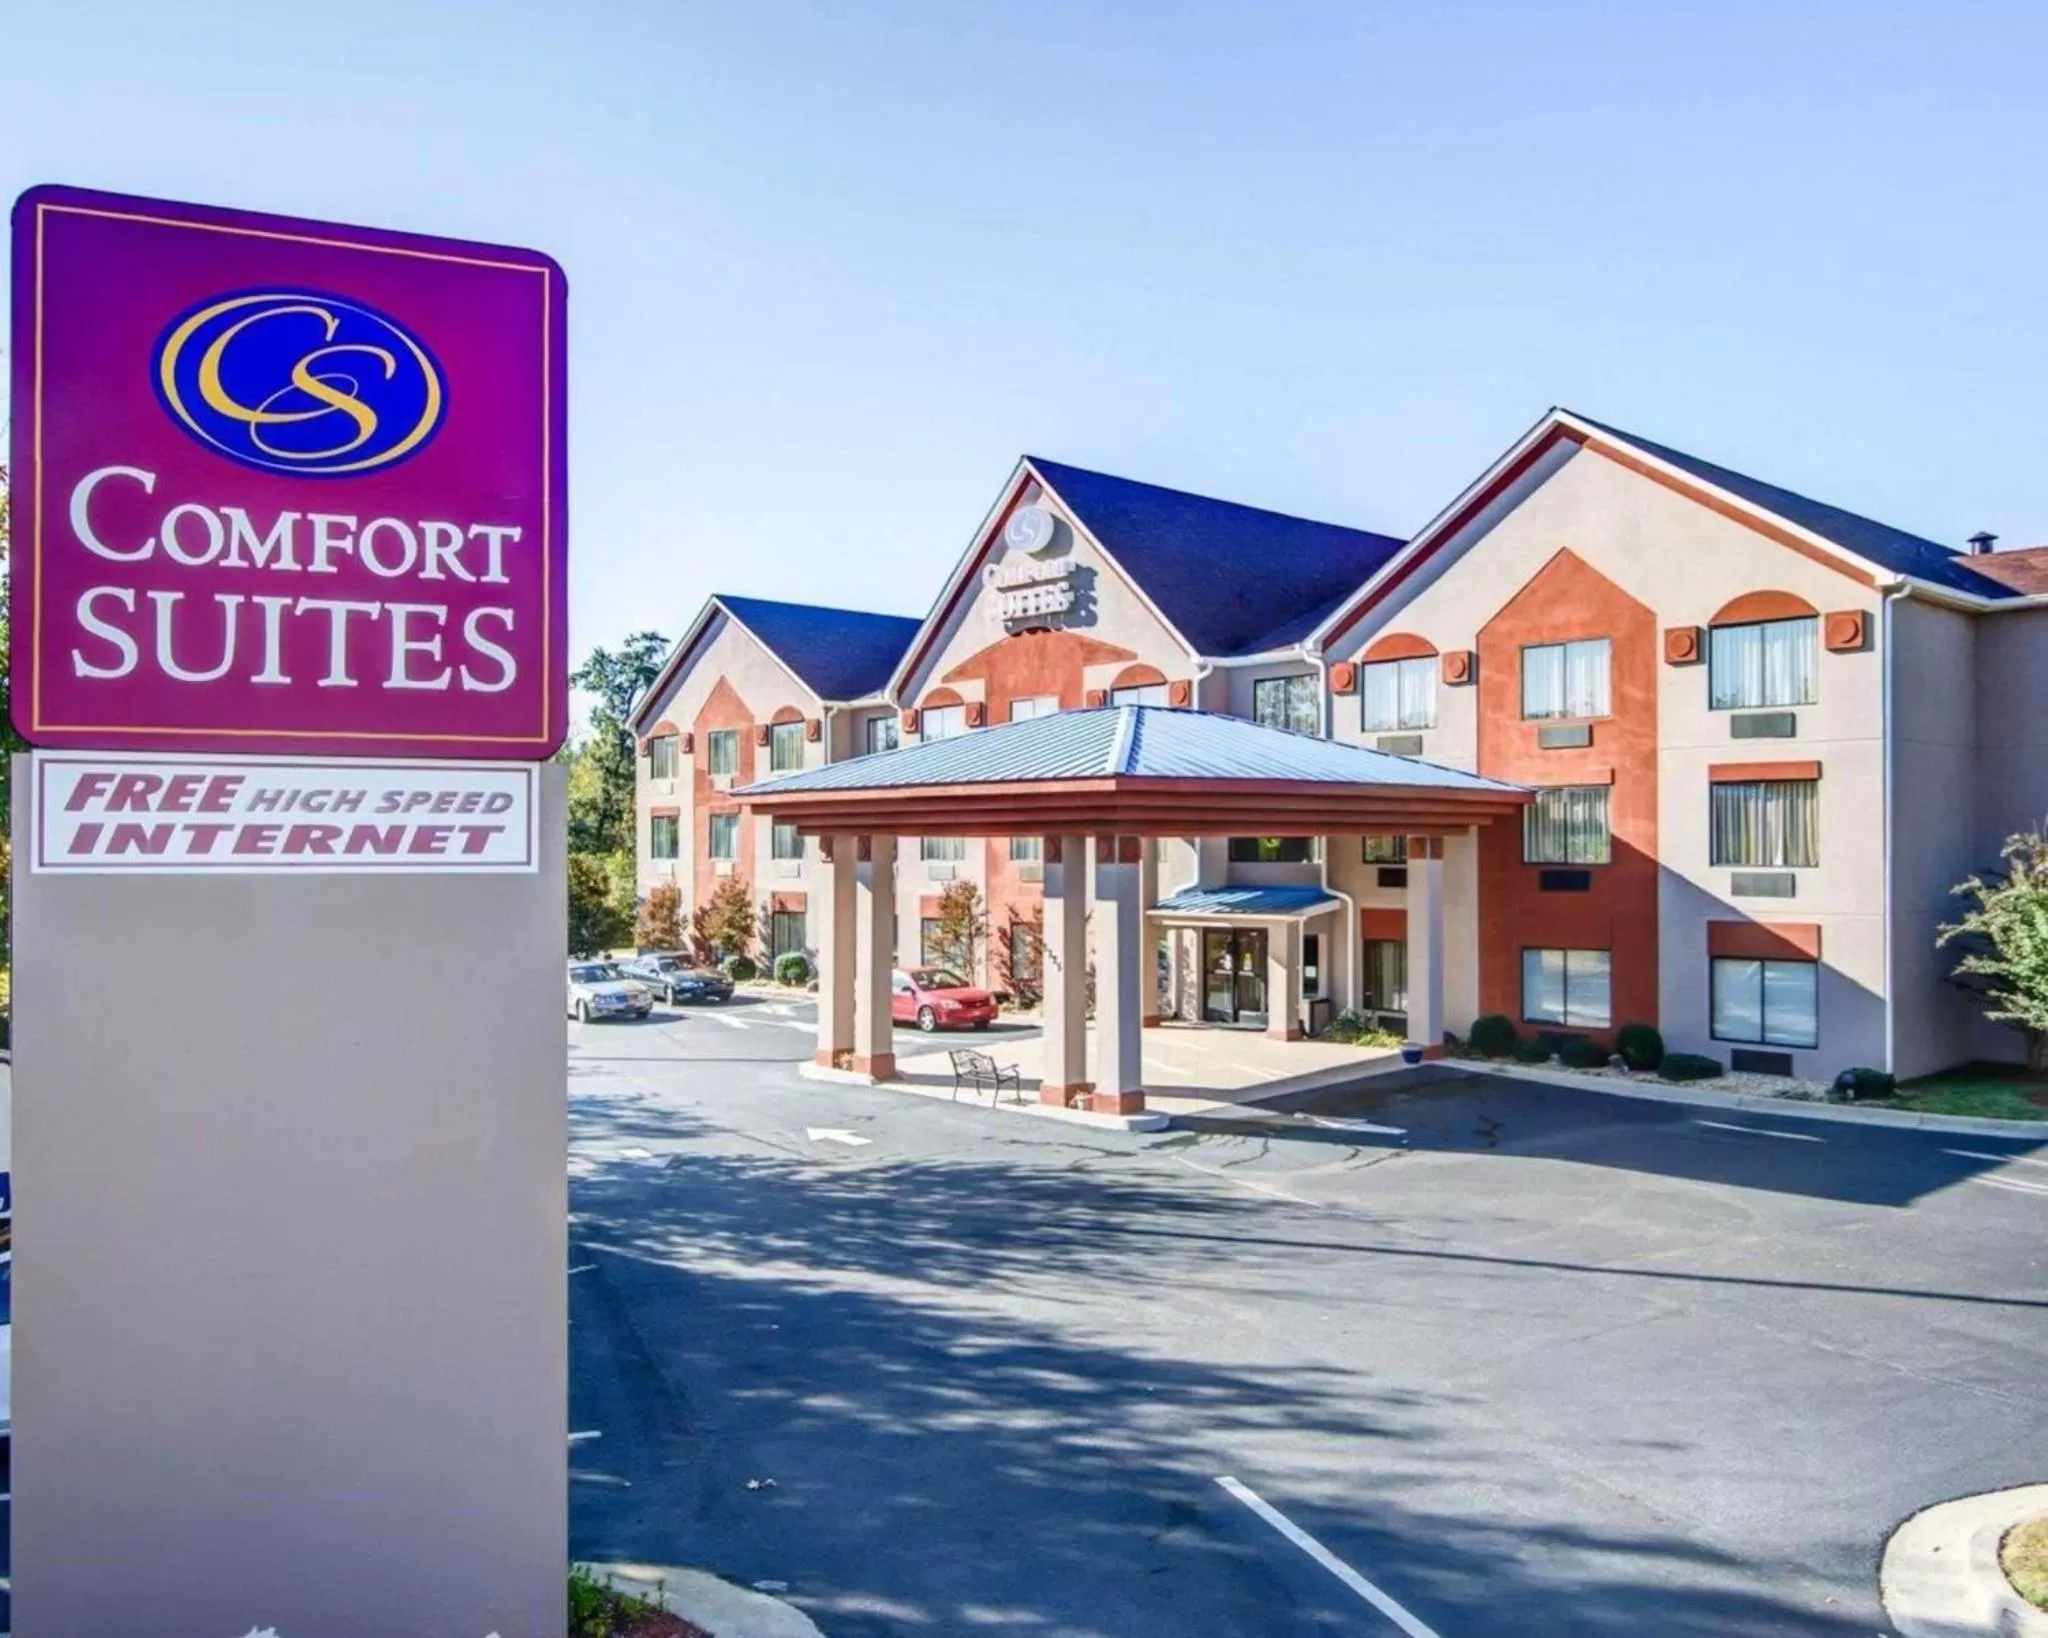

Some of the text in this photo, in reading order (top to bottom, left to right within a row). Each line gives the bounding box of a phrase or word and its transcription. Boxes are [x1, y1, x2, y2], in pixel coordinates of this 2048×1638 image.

[199, 305, 396, 459] CS
[69, 465, 522, 584] COMFORT
[72, 586, 518, 692] SUITES
[64, 773, 513, 814] FREE HIGH SPEED
[67, 823, 506, 855] INTERNET
